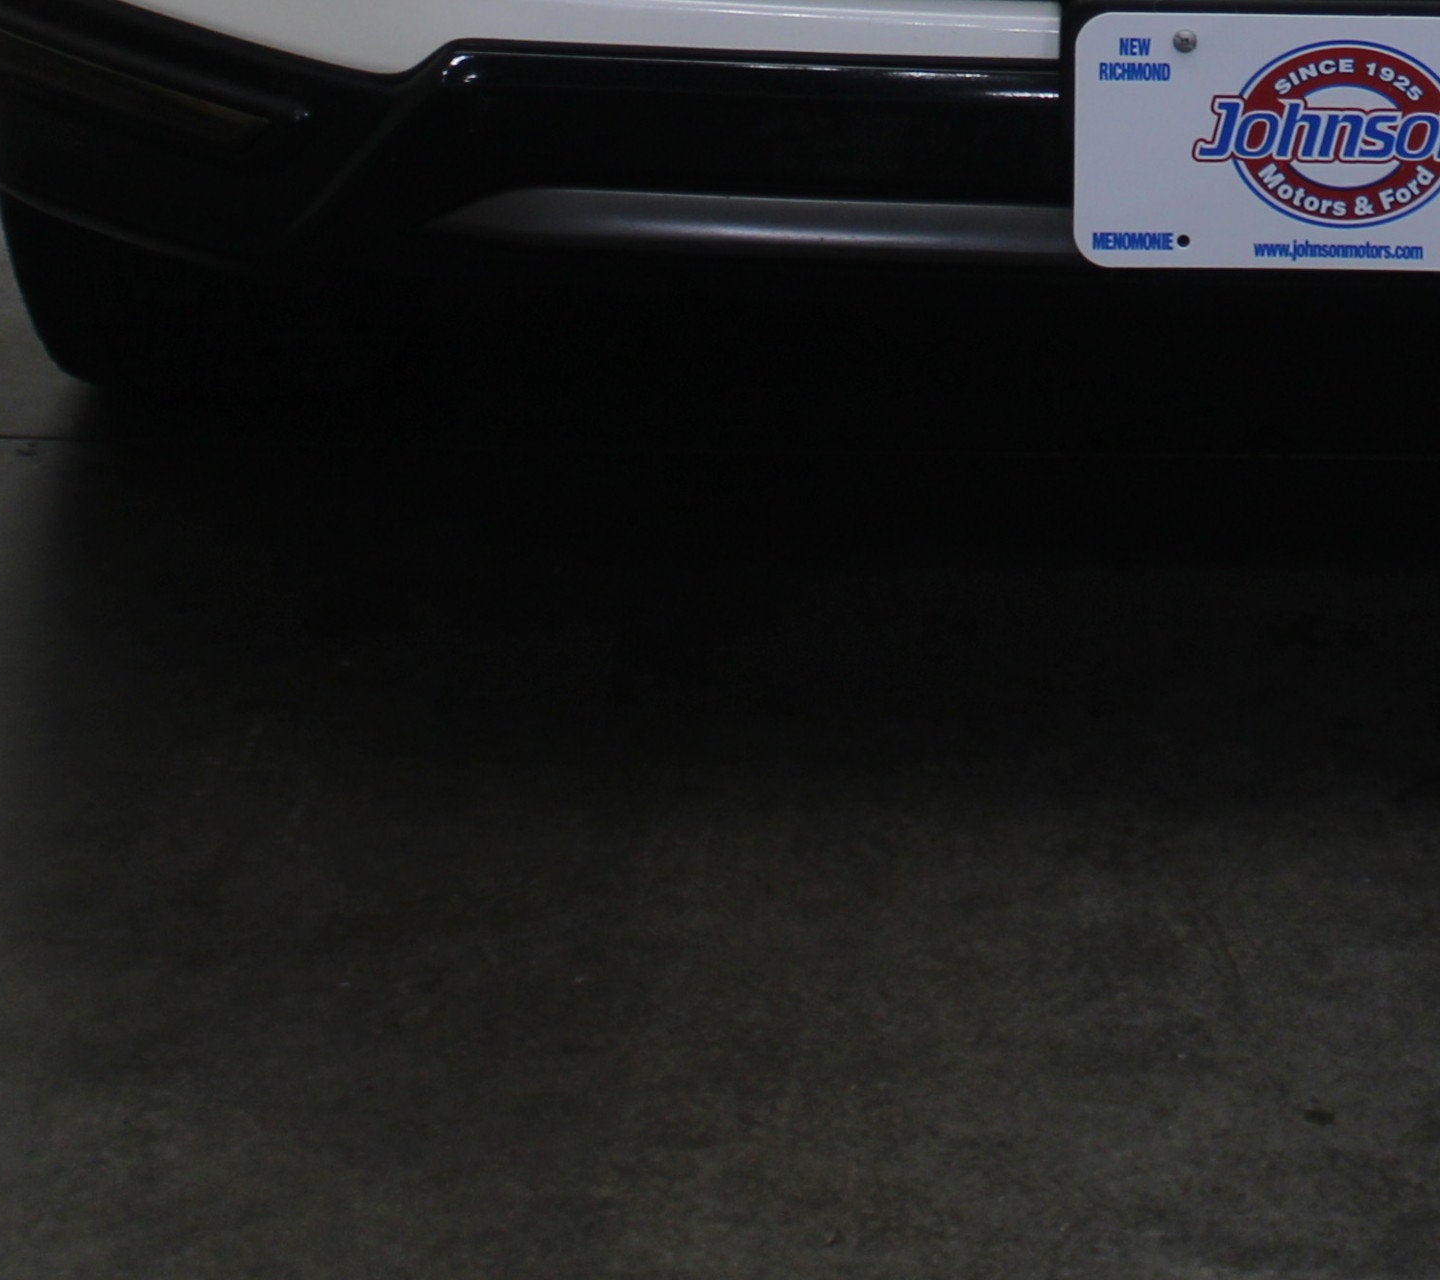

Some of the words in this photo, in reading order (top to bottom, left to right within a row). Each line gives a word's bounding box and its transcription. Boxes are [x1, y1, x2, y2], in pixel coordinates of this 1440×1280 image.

[1119, 38, 1150, 56] NEW
[1099, 62, 1170, 81] RICHMOND
[1274, 58, 1354, 95] SINCE
[1365, 62, 1424, 101] 1925
[1258, 163, 1347, 217] Motors
[1354, 196, 1374, 217] &
[1379, 165, 1435, 211] Ford
[1092, 232, 1174, 250] MENOMONIE
[1253, 240, 1424, 261] www.johnsonmotors.com
